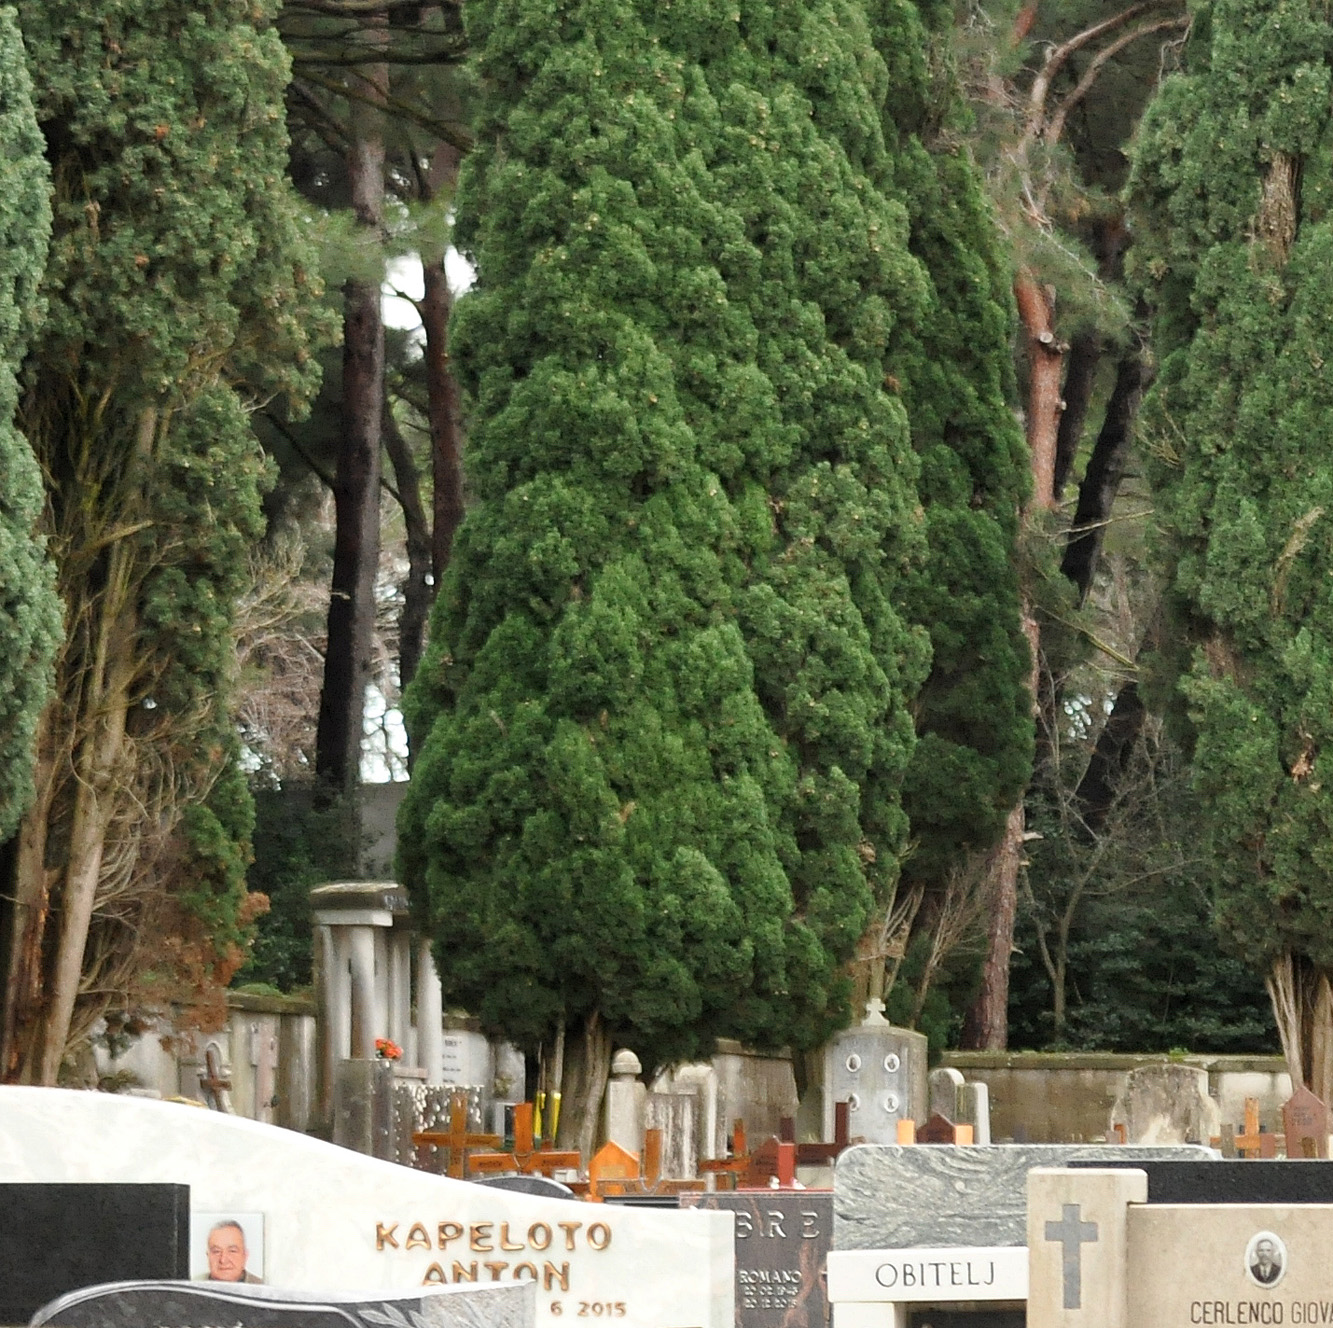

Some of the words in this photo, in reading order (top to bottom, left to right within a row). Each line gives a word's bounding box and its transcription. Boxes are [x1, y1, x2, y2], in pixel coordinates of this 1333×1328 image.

[375, 1221, 612, 1251] KAPELOTO
[421, 1260, 570, 1291] ANTON
[739, 1270, 802, 1284] ROMANO
[875, 1262, 995, 1287] OBITELJ
[577, 1300, 627, 1317] 2015
[1190, 1301, 1284, 1325] CERLENCO
